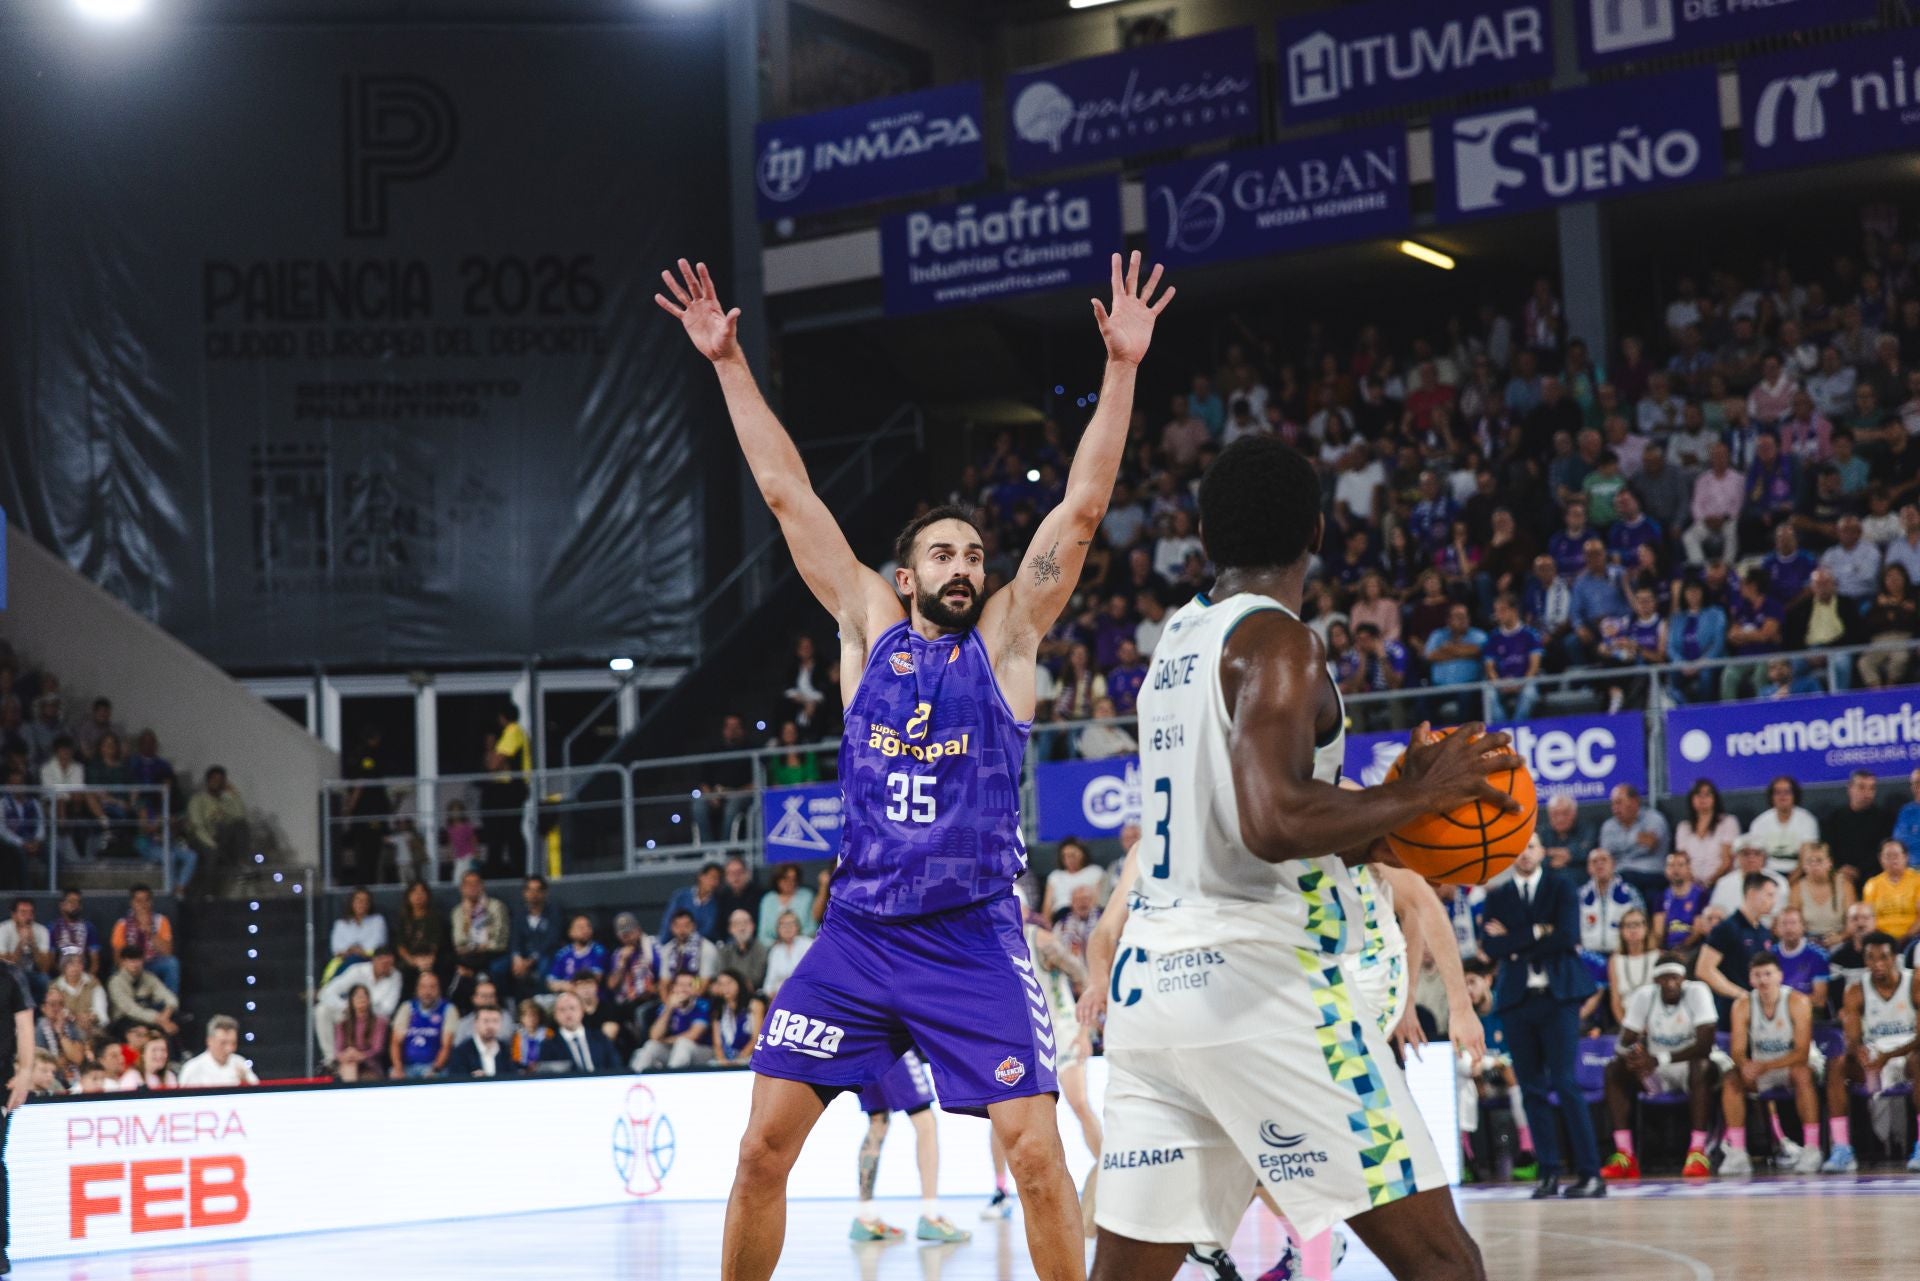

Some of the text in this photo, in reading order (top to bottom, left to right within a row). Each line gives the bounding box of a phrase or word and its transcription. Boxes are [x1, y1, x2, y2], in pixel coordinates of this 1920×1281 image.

[1850, 56, 1920, 114] ni
[814, 115, 981, 172] INMAPA
[1232, 146, 1397, 211] GABAN
[907, 189, 1091, 258] Peñafría
[202, 253, 604, 324] PALENCIA 2026
[869, 734, 969, 763] agropal
[886, 772, 937, 823] 35
[1153, 777, 1171, 879] 3
[766, 1008, 845, 1053] gaza
[67, 1109, 247, 1150] PRIMERA
[1103, 1148, 1184, 1170] BALEARIA
[1259, 1149, 1328, 1178] Esports
[69, 1153, 250, 1240] FEB
